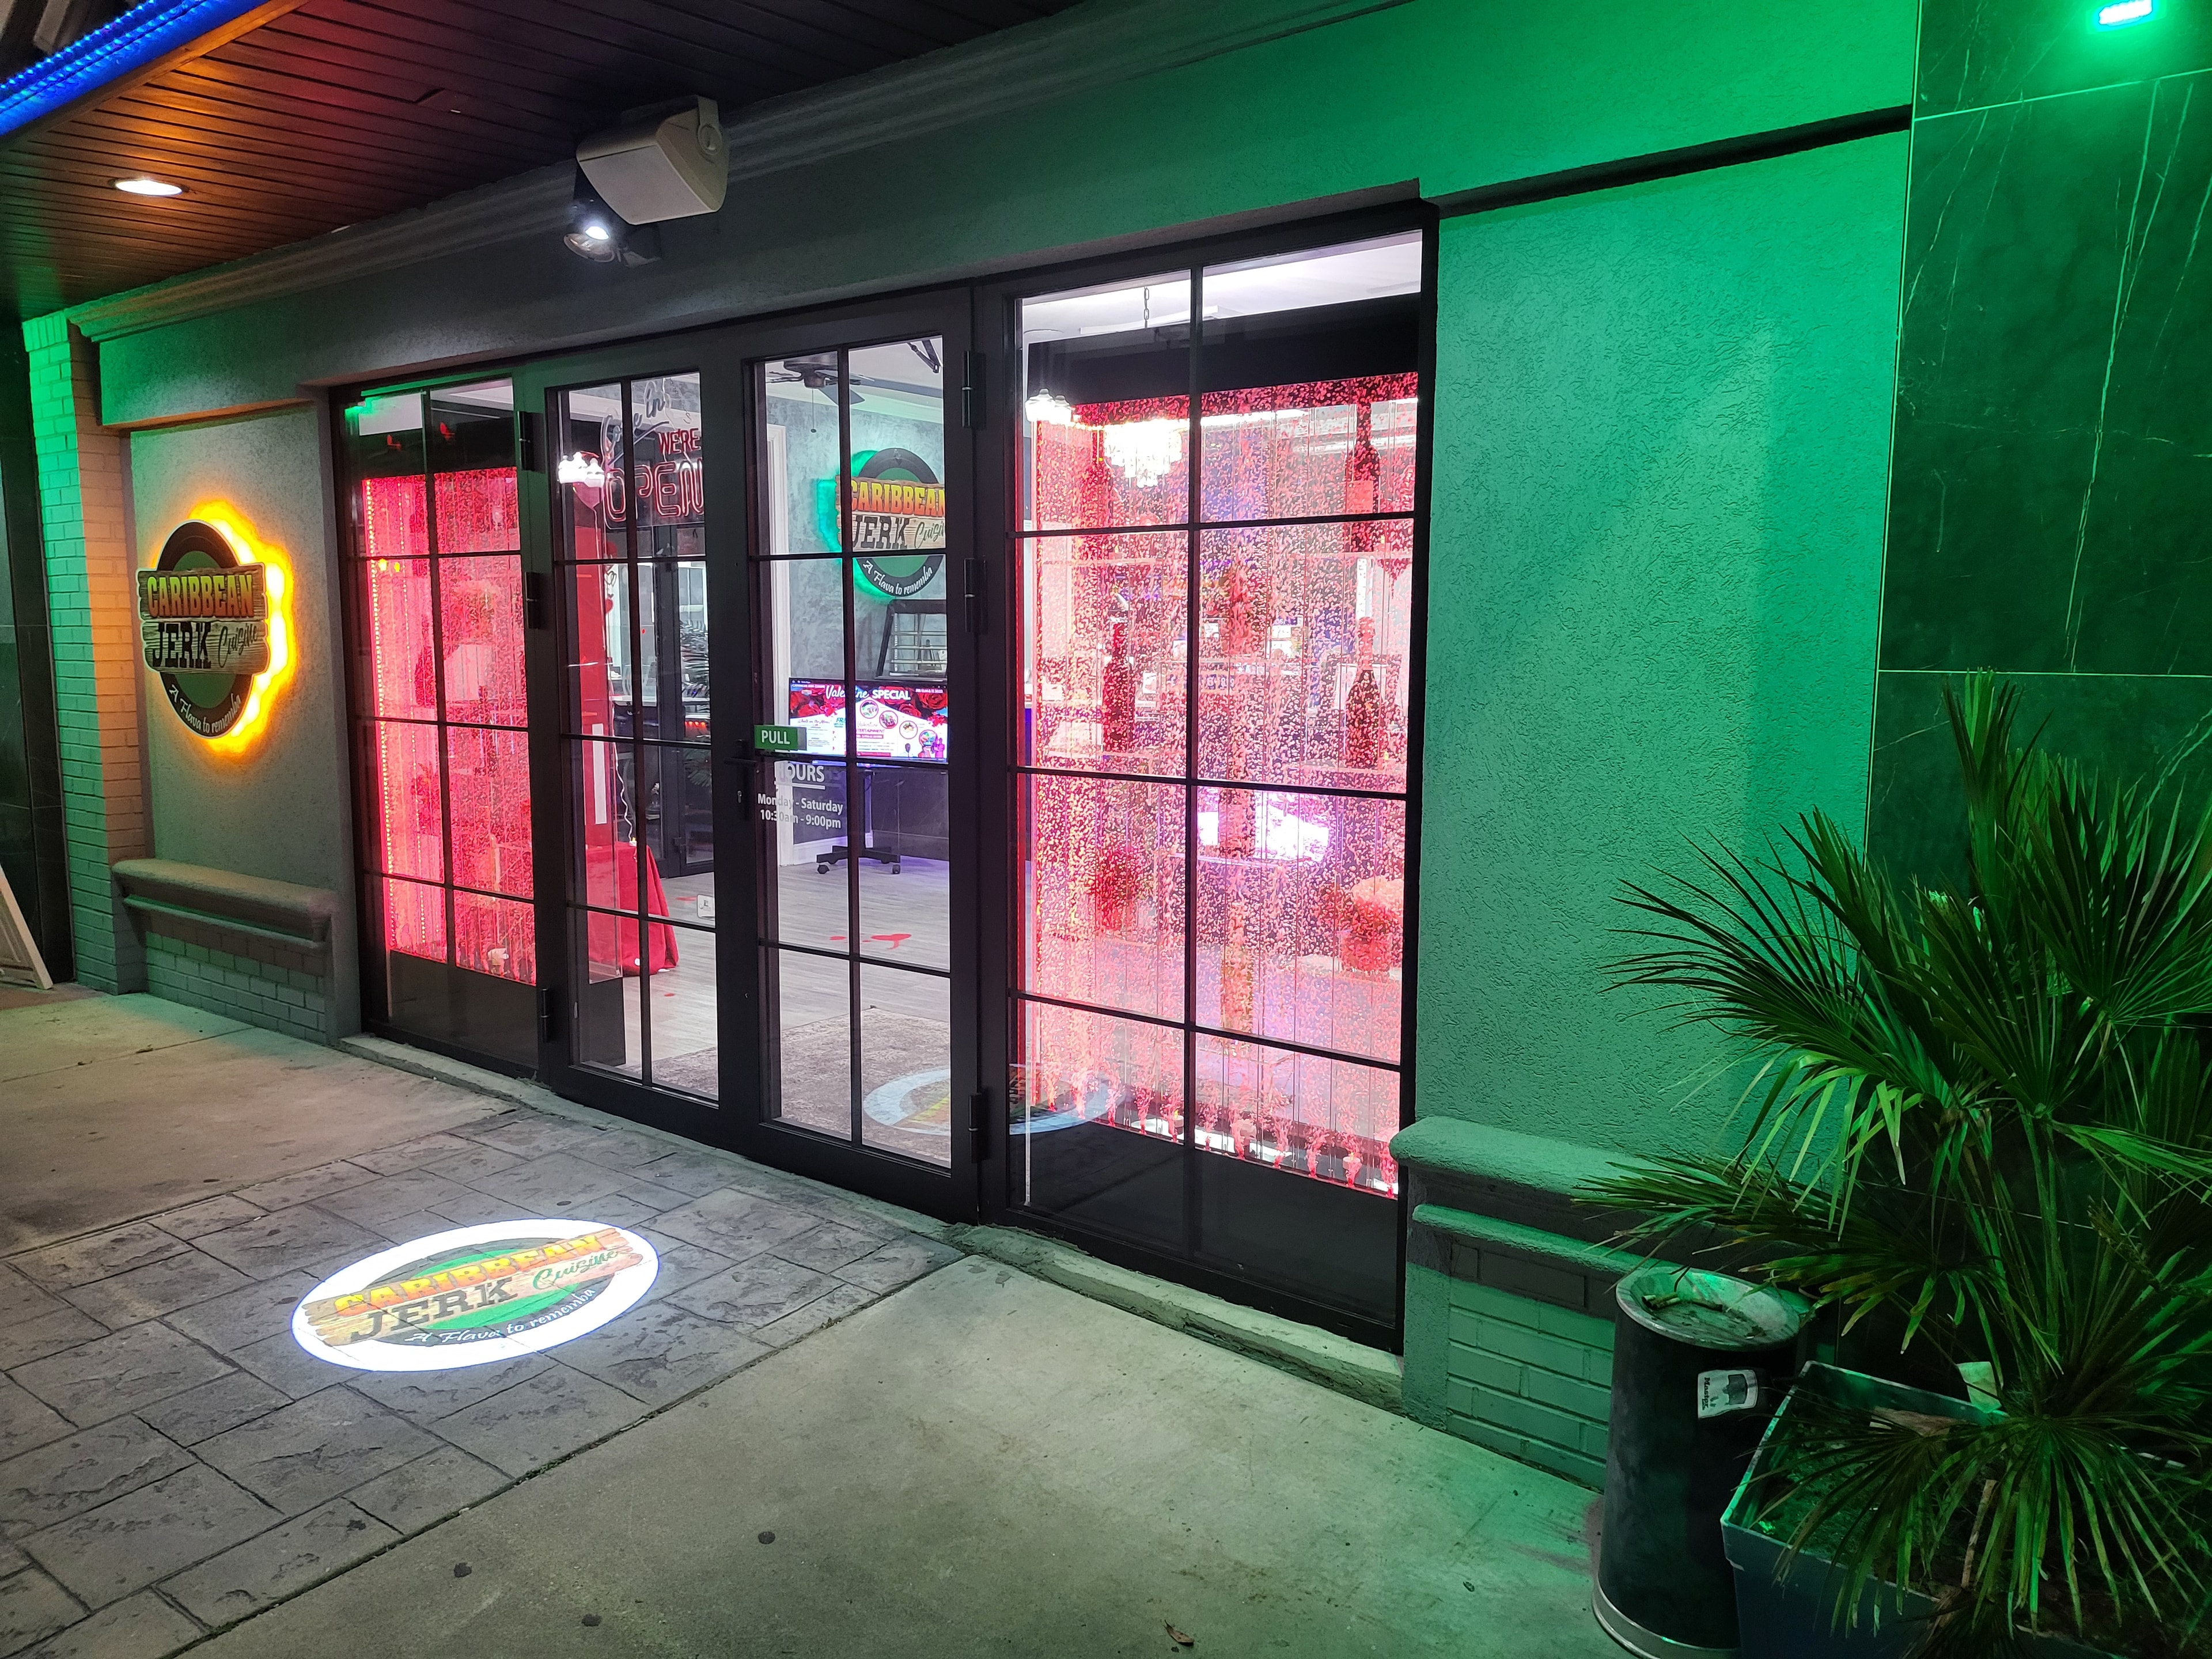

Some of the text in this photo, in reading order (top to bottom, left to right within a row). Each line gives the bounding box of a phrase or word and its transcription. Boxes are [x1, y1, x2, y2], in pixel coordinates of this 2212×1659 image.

[605, 458, 704, 521] OPEN
[853, 514, 945, 550] JERK Cuisi
[147, 574, 255, 619] CARIBBEAN
[863, 560, 933, 595] A Flava to rememba
[152, 621, 258, 669] JERK Cuisine
[169, 684, 241, 734] A Flava to rememba
[825, 684, 911, 700] Valene SPECIAL
[761, 729, 791, 745] PULL
[775, 762, 825, 783] HOURS
[757, 793, 794, 810] Monday
[801, 797, 844, 816] Saturday
[760, 809, 799, 824] 10:30am
[806, 814, 842, 830] 9:00pm
[334, 1234, 603, 1317] CARIBBEAN
[350, 1250, 618, 1342] JERK Cuisine
[440, 1329, 502, 1343] Flava
[506, 1323, 525, 1334] to
[529, 1287, 597, 1327] rememba
